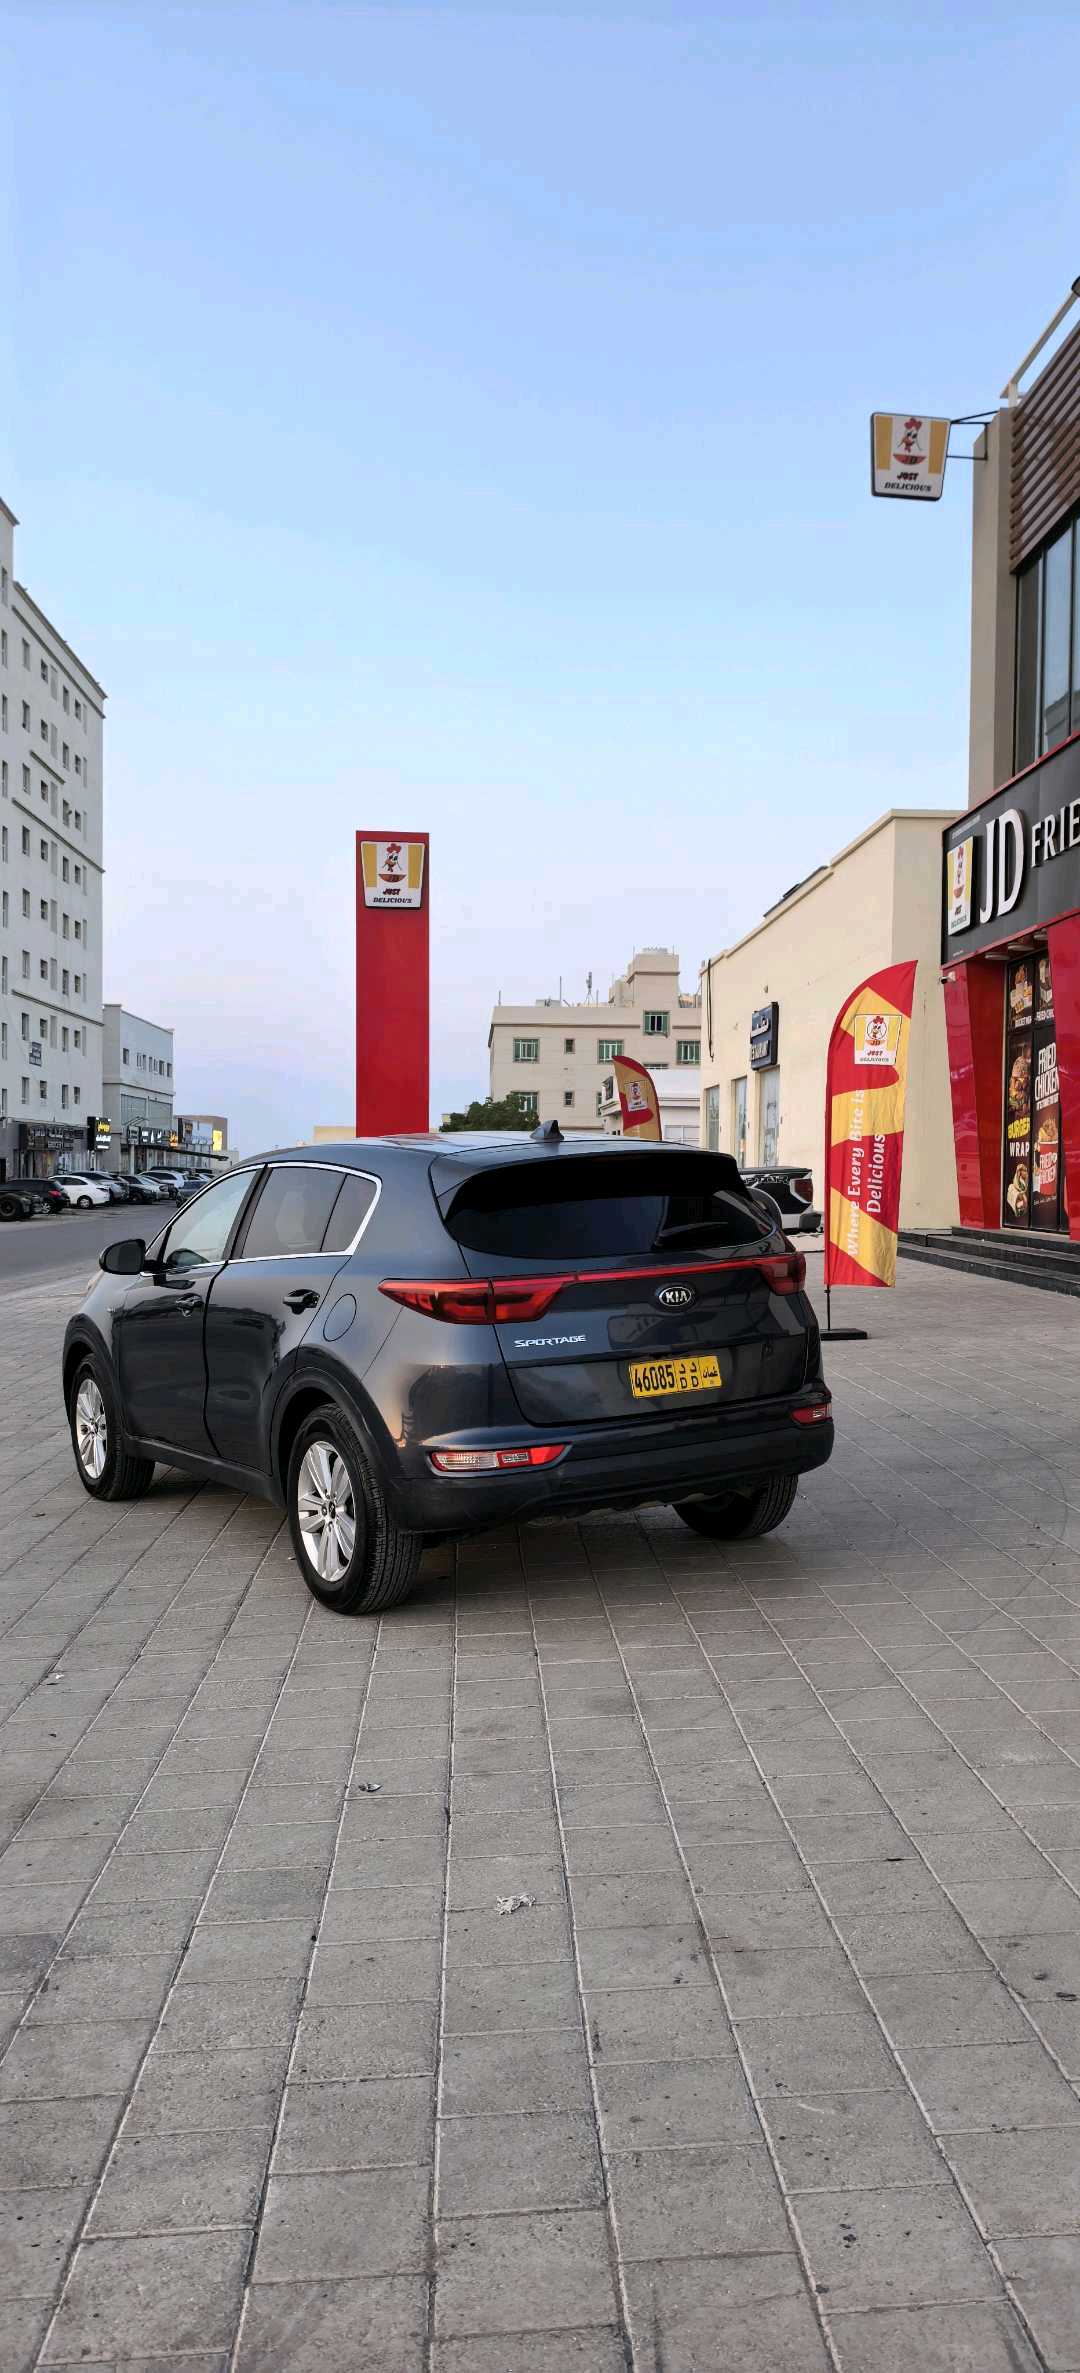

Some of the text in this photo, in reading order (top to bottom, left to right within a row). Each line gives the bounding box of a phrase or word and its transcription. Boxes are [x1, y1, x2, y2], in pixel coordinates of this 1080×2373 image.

[884, 481, 932, 491] DELICIOUS
[897, 472, 919, 480] JUST
[980, 808, 1024, 924] JD
[383, 888, 401, 896] JUST
[1038, 1042, 1056, 1076] FRIED
[1035, 1066, 1059, 1101] CHICKEN
[1007, 1116, 1031, 1139] BURGER
[1009, 1142, 1030, 1157] WRAP
[847, 1147, 864, 1196] Every
[866, 1133, 885, 1213] Delicious
[847, 1200, 861, 1256] Where
[665, 1290, 688, 1303] KIA
[514, 1334, 587, 1348] SPORTAGE
[634, 1364, 675, 1392] 46085
